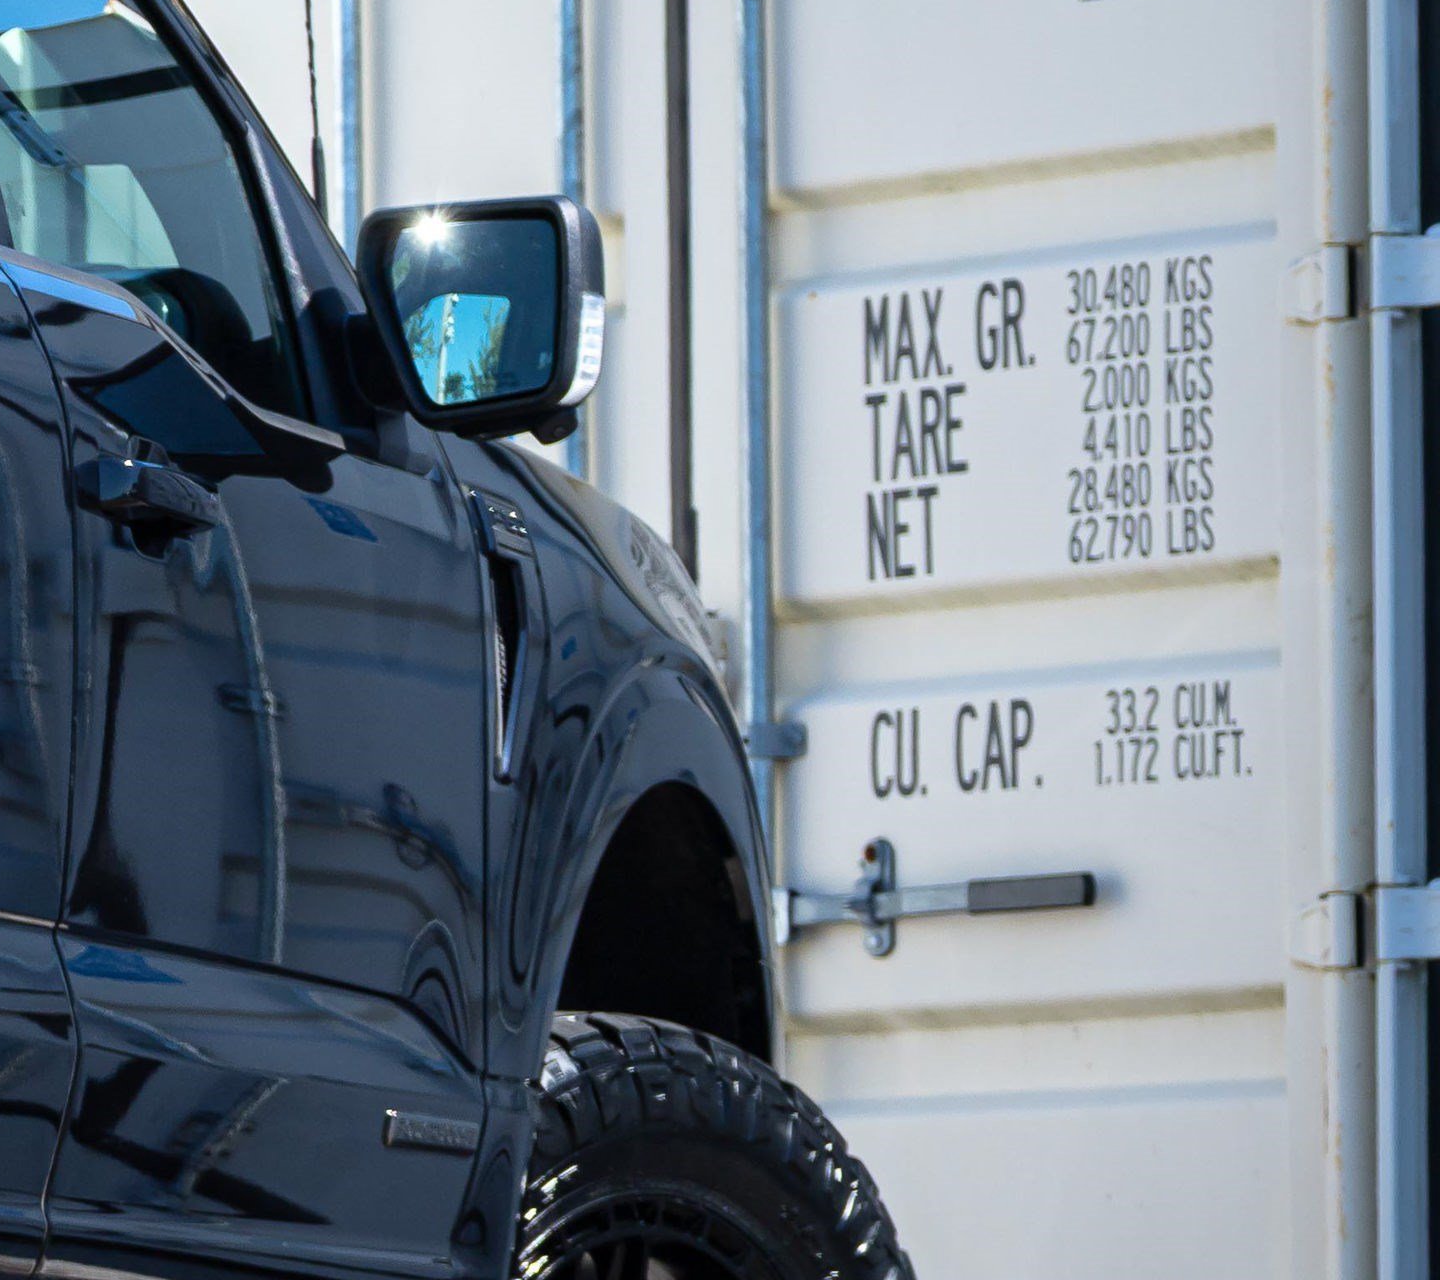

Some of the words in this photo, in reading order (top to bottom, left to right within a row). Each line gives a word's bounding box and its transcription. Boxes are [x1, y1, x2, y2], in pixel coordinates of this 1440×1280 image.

[1066, 261, 1151, 314] 30.480
[1165, 255, 1213, 304] KGS
[863, 288, 953, 385] MAX.
[975, 278, 1036, 371] GR.
[1165, 306, 1213, 354] LBS
[1165, 355, 1214, 404] KGS
[864, 383, 969, 483] TARE
[1165, 407, 1214, 456] LBS
[1067, 463, 1152, 514] 28.480
[1165, 456, 1214, 504] KGS
[866, 485, 940, 581] NET
[1166, 507, 1215, 556] LBS
[1105, 685, 1160, 735] 33.2
[870, 707, 928, 800] CU.
[954, 698, 1044, 793] CAP.
[1094, 735, 1160, 786] 1.172
